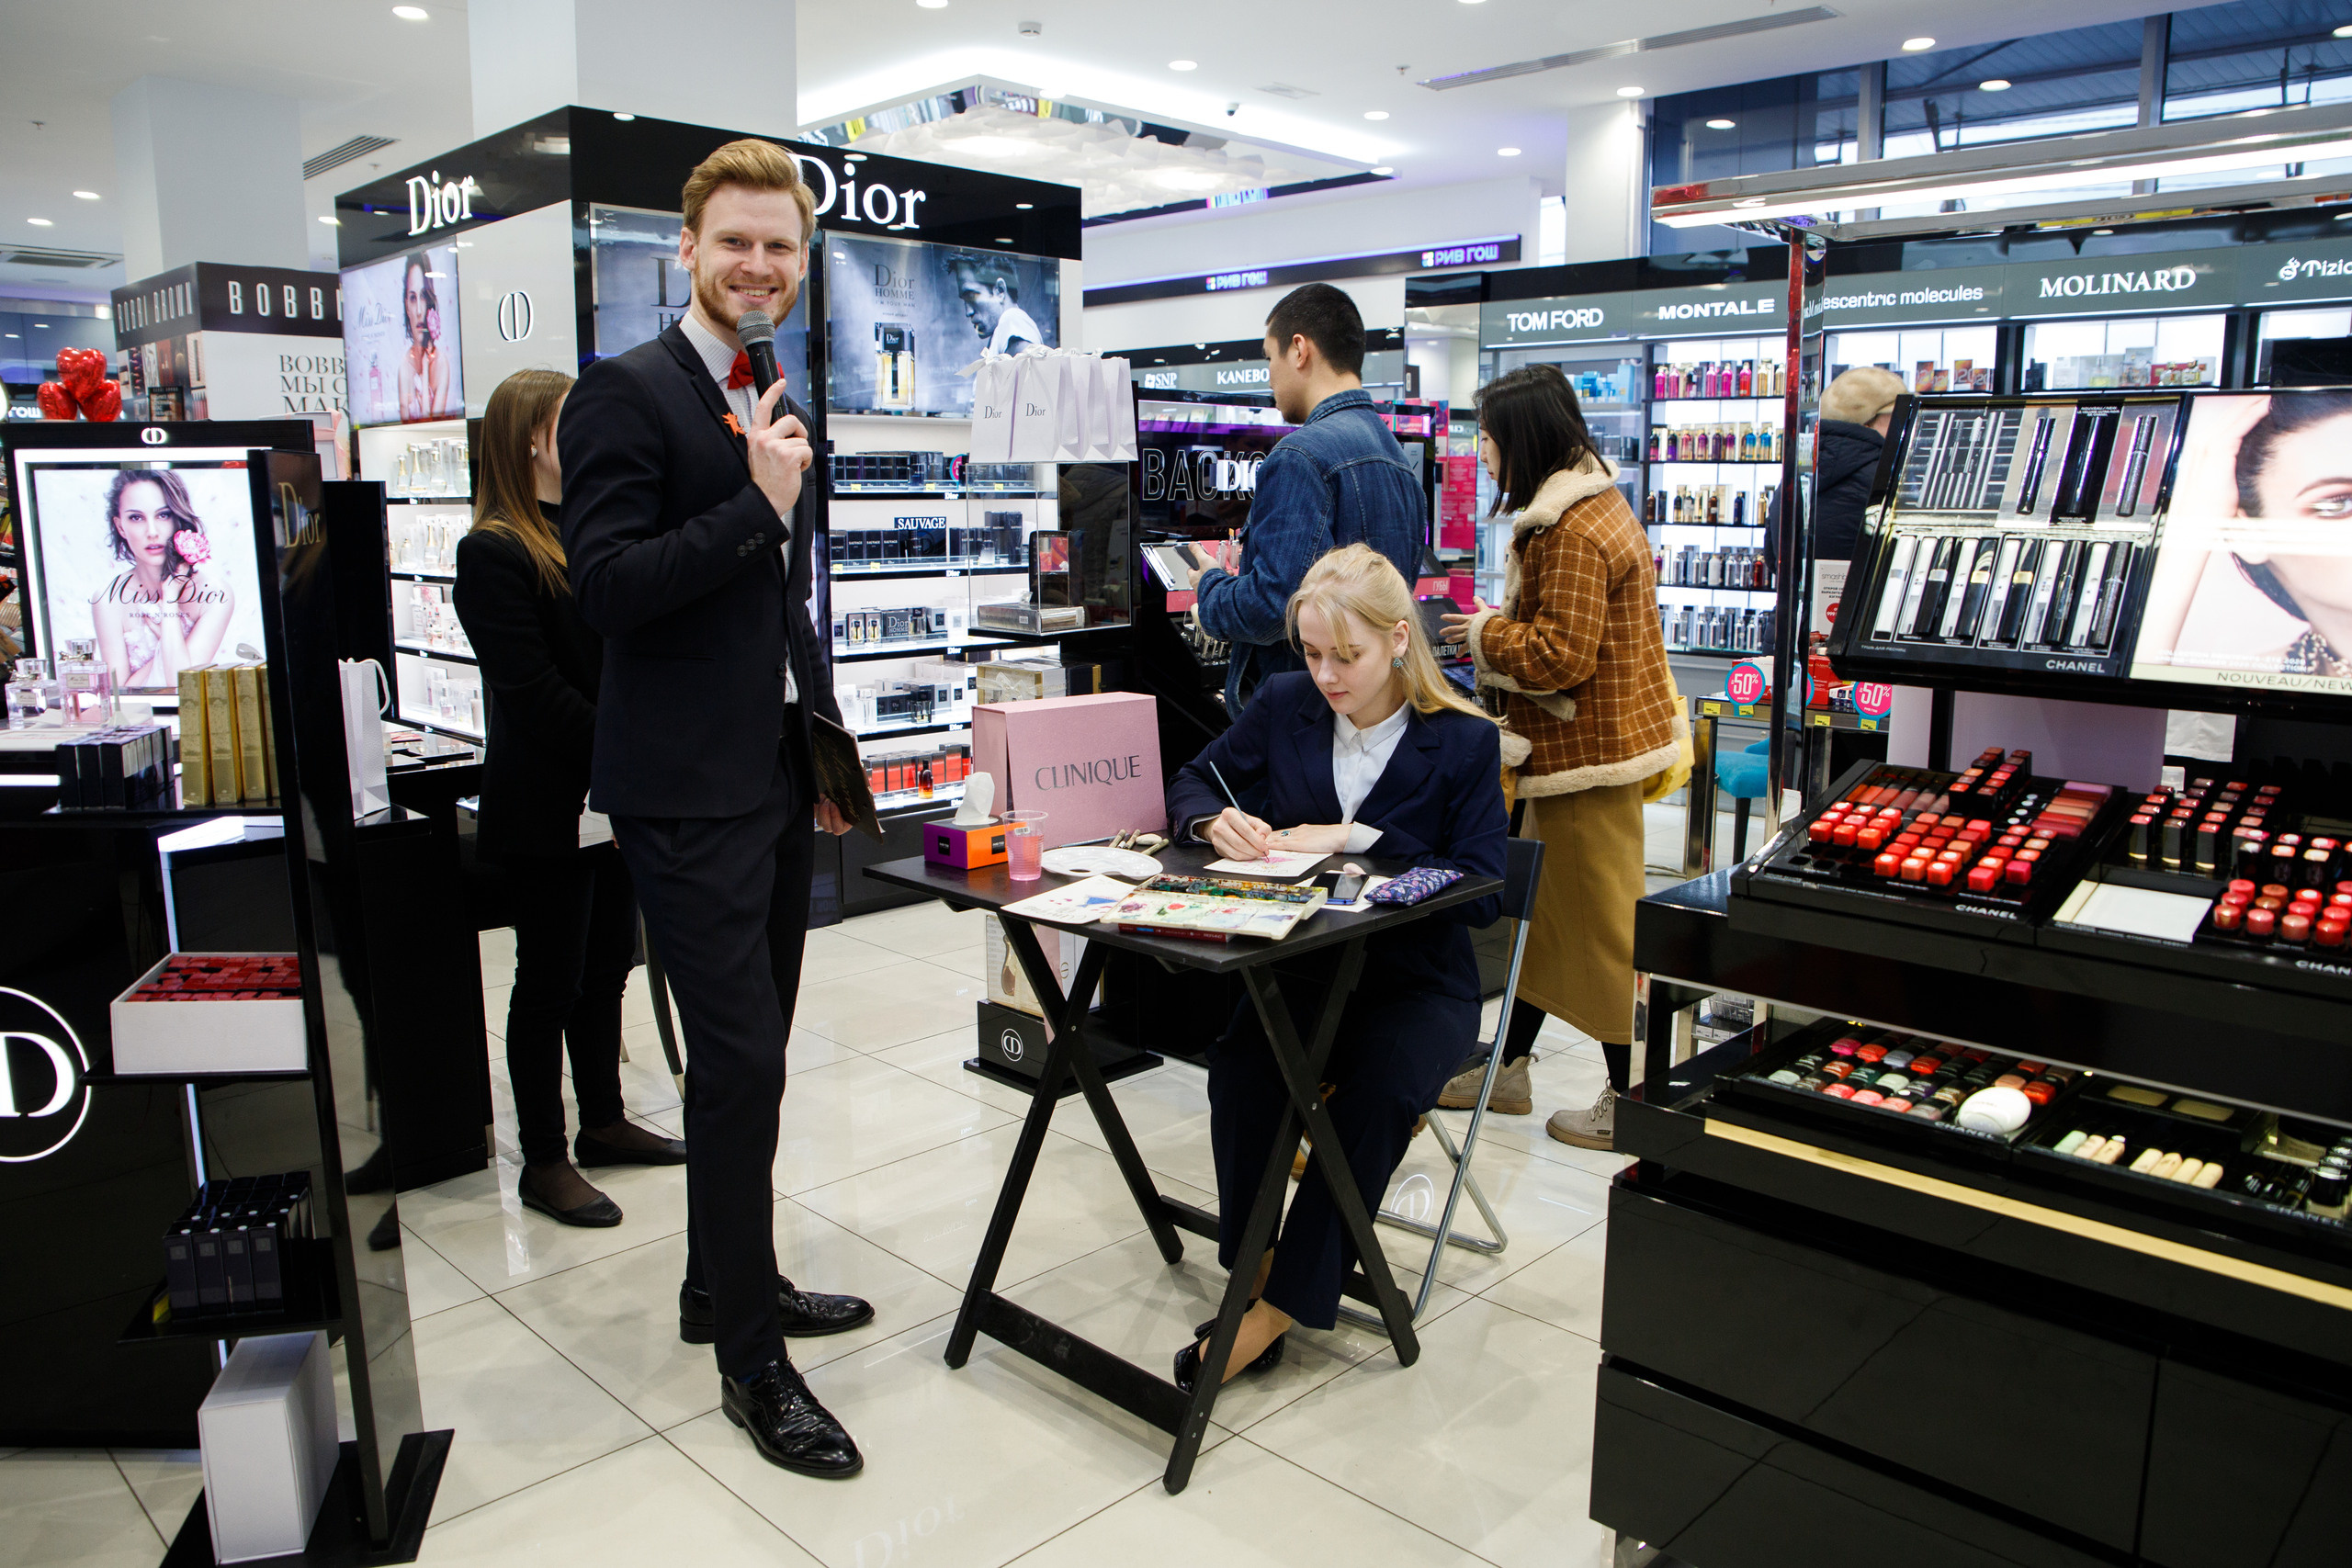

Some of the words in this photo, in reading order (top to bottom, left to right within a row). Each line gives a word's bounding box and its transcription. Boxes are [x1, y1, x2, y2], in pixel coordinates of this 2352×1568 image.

[786, 152, 926, 229] Dior
[405, 170, 475, 236] Dior
[1435, 247, 1465, 266] РИВ
[1466, 244, 1498, 263] ГОШ
[874, 264, 915, 289] Dior
[1216, 273, 1240, 289] РИВ
[1241, 270, 1268, 287] ГОШ
[2039, 268, 2197, 299] MOLINARD
[876, 288, 915, 300] HOMME
[1824, 288, 1896, 310] escentric
[1899, 284, 1984, 305] molecules
[1507, 310, 1548, 333] TOM
[1549, 307, 1604, 330] FORD
[1658, 299, 1775, 321] MONTALE
[1155, 372, 1177, 387] SNP
[1216, 367, 1270, 385] KANEBO
[984, 405, 1002, 419] Dior
[1025, 402, 1046, 417] Dior
[277, 481, 321, 548] Dior
[898, 517, 946, 530] SAUVAGE
[87, 574, 163, 605] Miss
[166, 574, 229, 604] Dior
[888, 616, 909, 627] Dior
[2045, 659, 2106, 673] CHANEL
[1733, 673, 1758, 695] 50%
[1860, 682, 1891, 707] 50%
[1035, 754, 1142, 792] CLINIQUE
[1955, 903, 2018, 919] CHANEL
[1934, 1121, 1995, 1140] CHANEL
